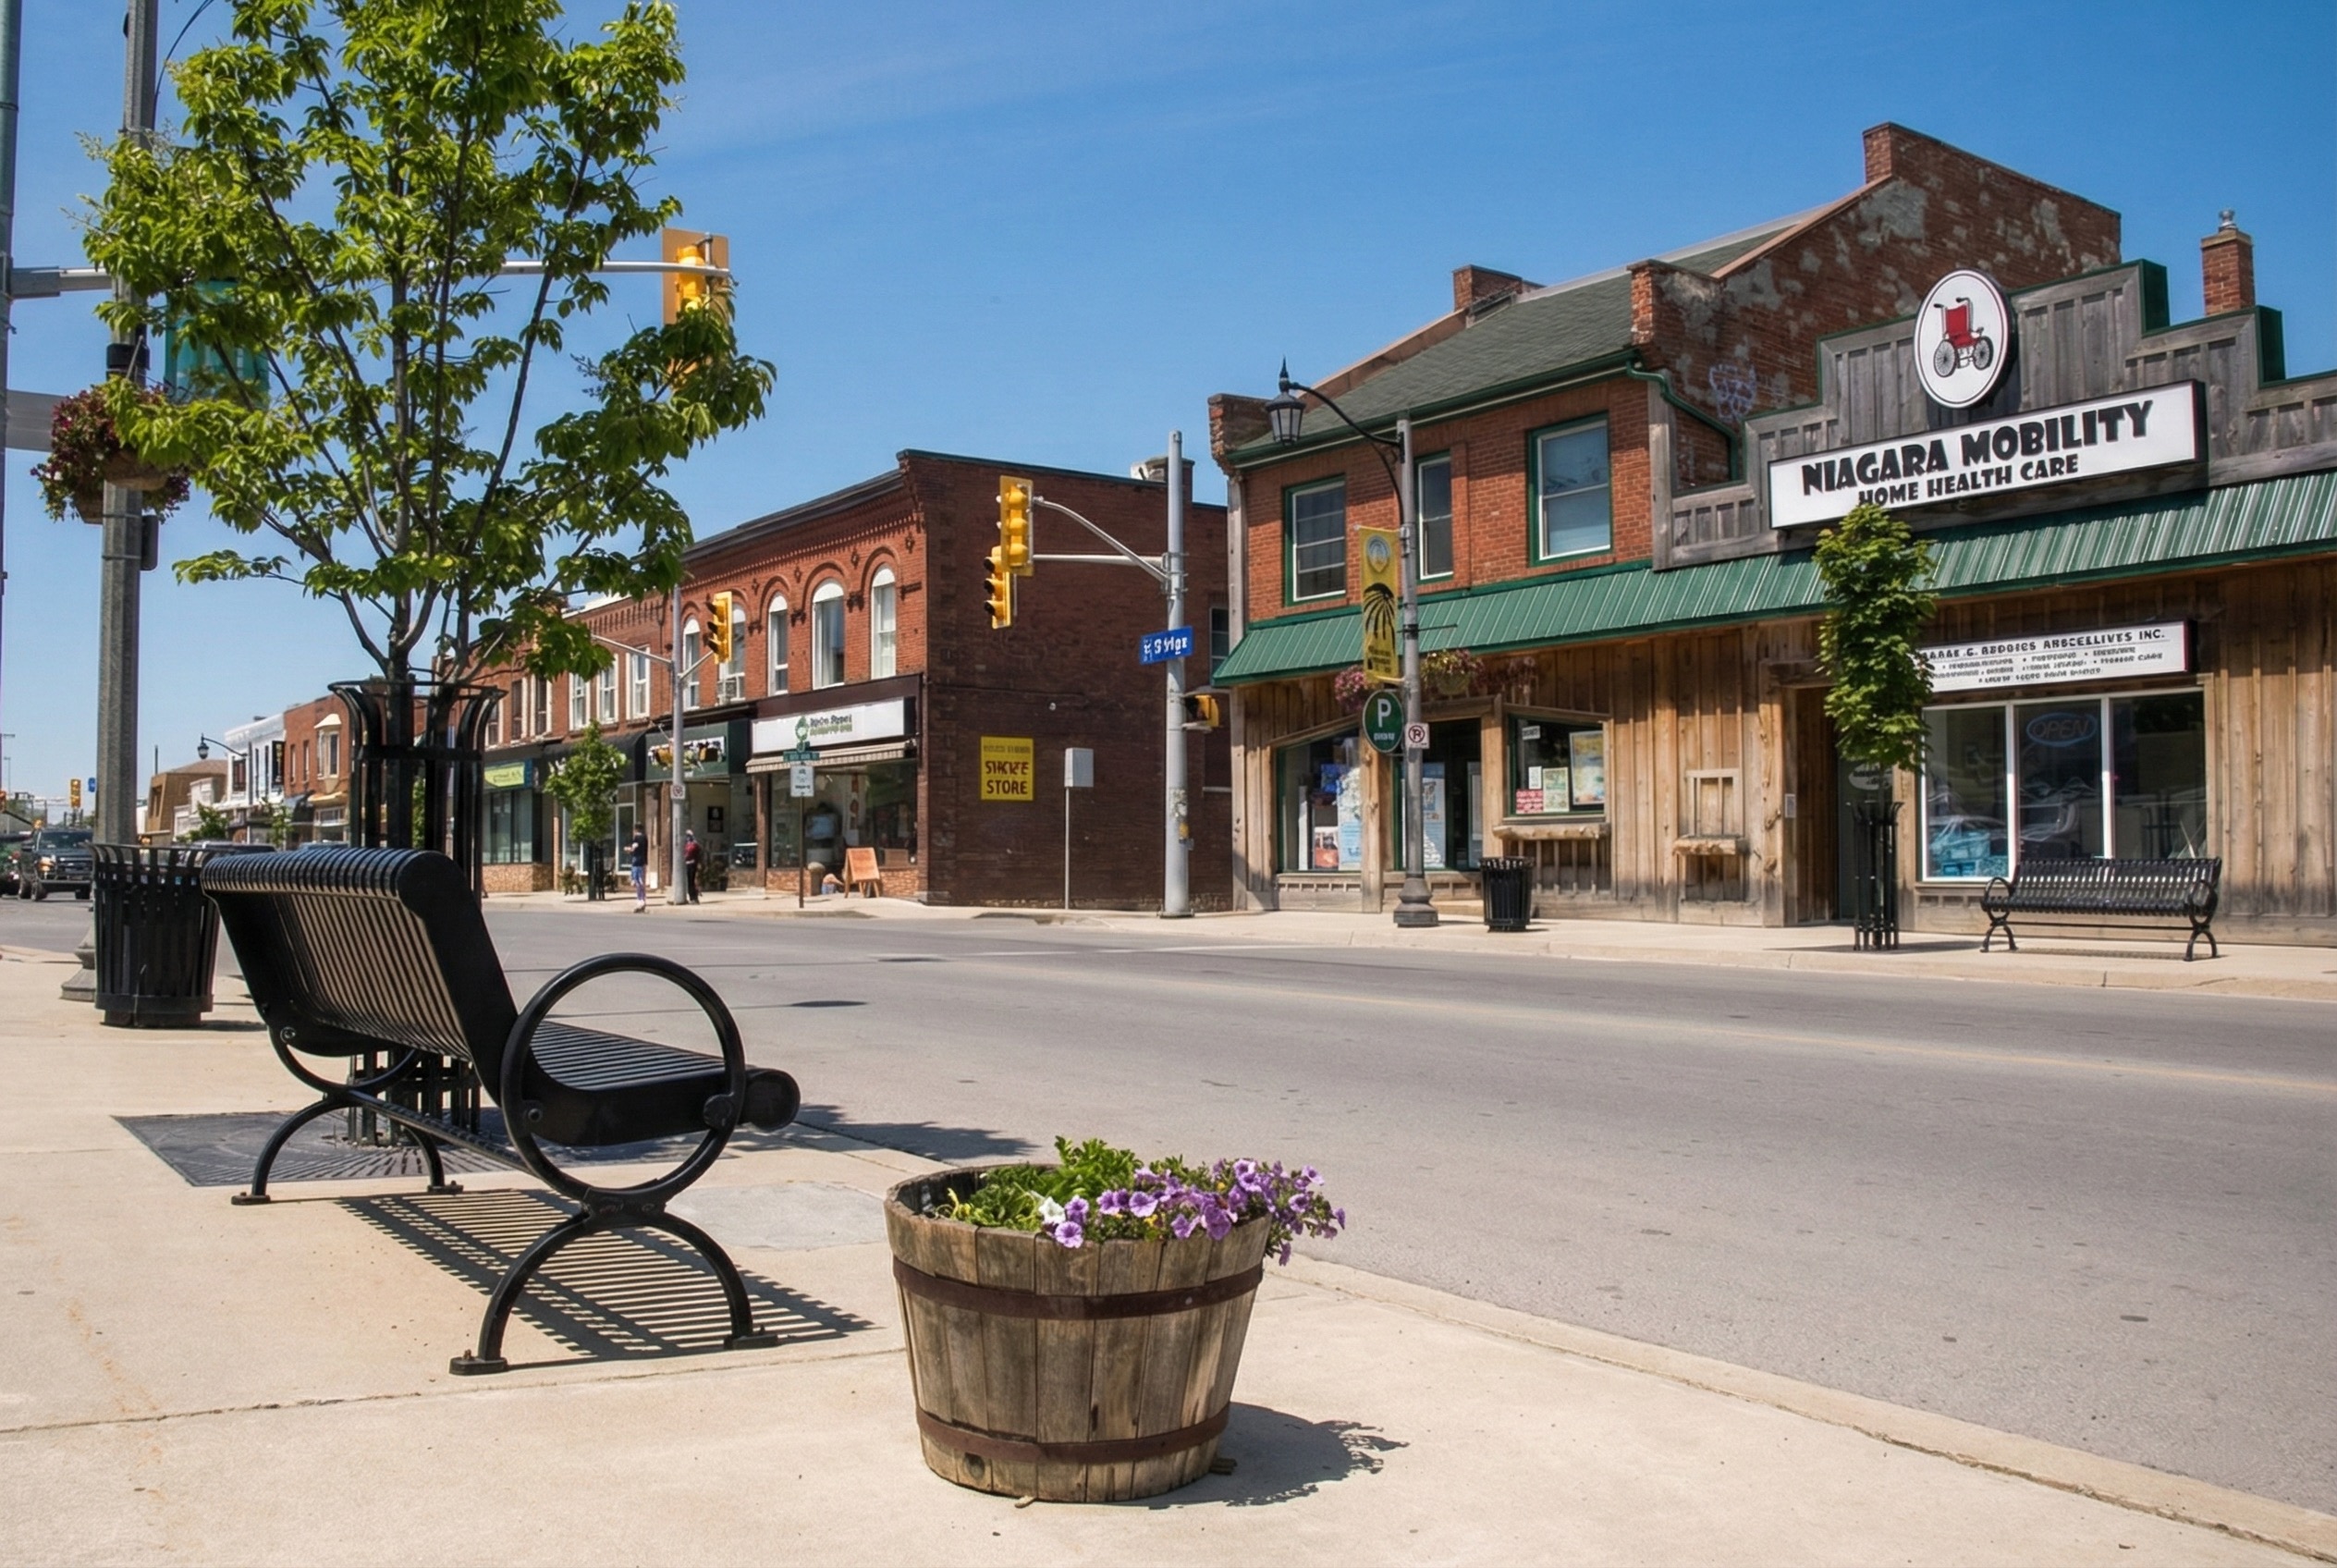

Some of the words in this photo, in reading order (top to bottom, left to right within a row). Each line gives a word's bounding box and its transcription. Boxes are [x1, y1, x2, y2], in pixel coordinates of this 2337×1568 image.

[1802, 439, 1949, 496] NIAGARA
[1961, 399, 2153, 467] MOBILITY
[1858, 482, 1918, 507] HOME
[1927, 465, 2013, 497] HEALTH
[2020, 453, 2078, 481] CARE
[2138, 629, 2165, 641] INC.
[1377, 698, 1391, 728] P
[2033, 719, 2089, 739] OPEN
